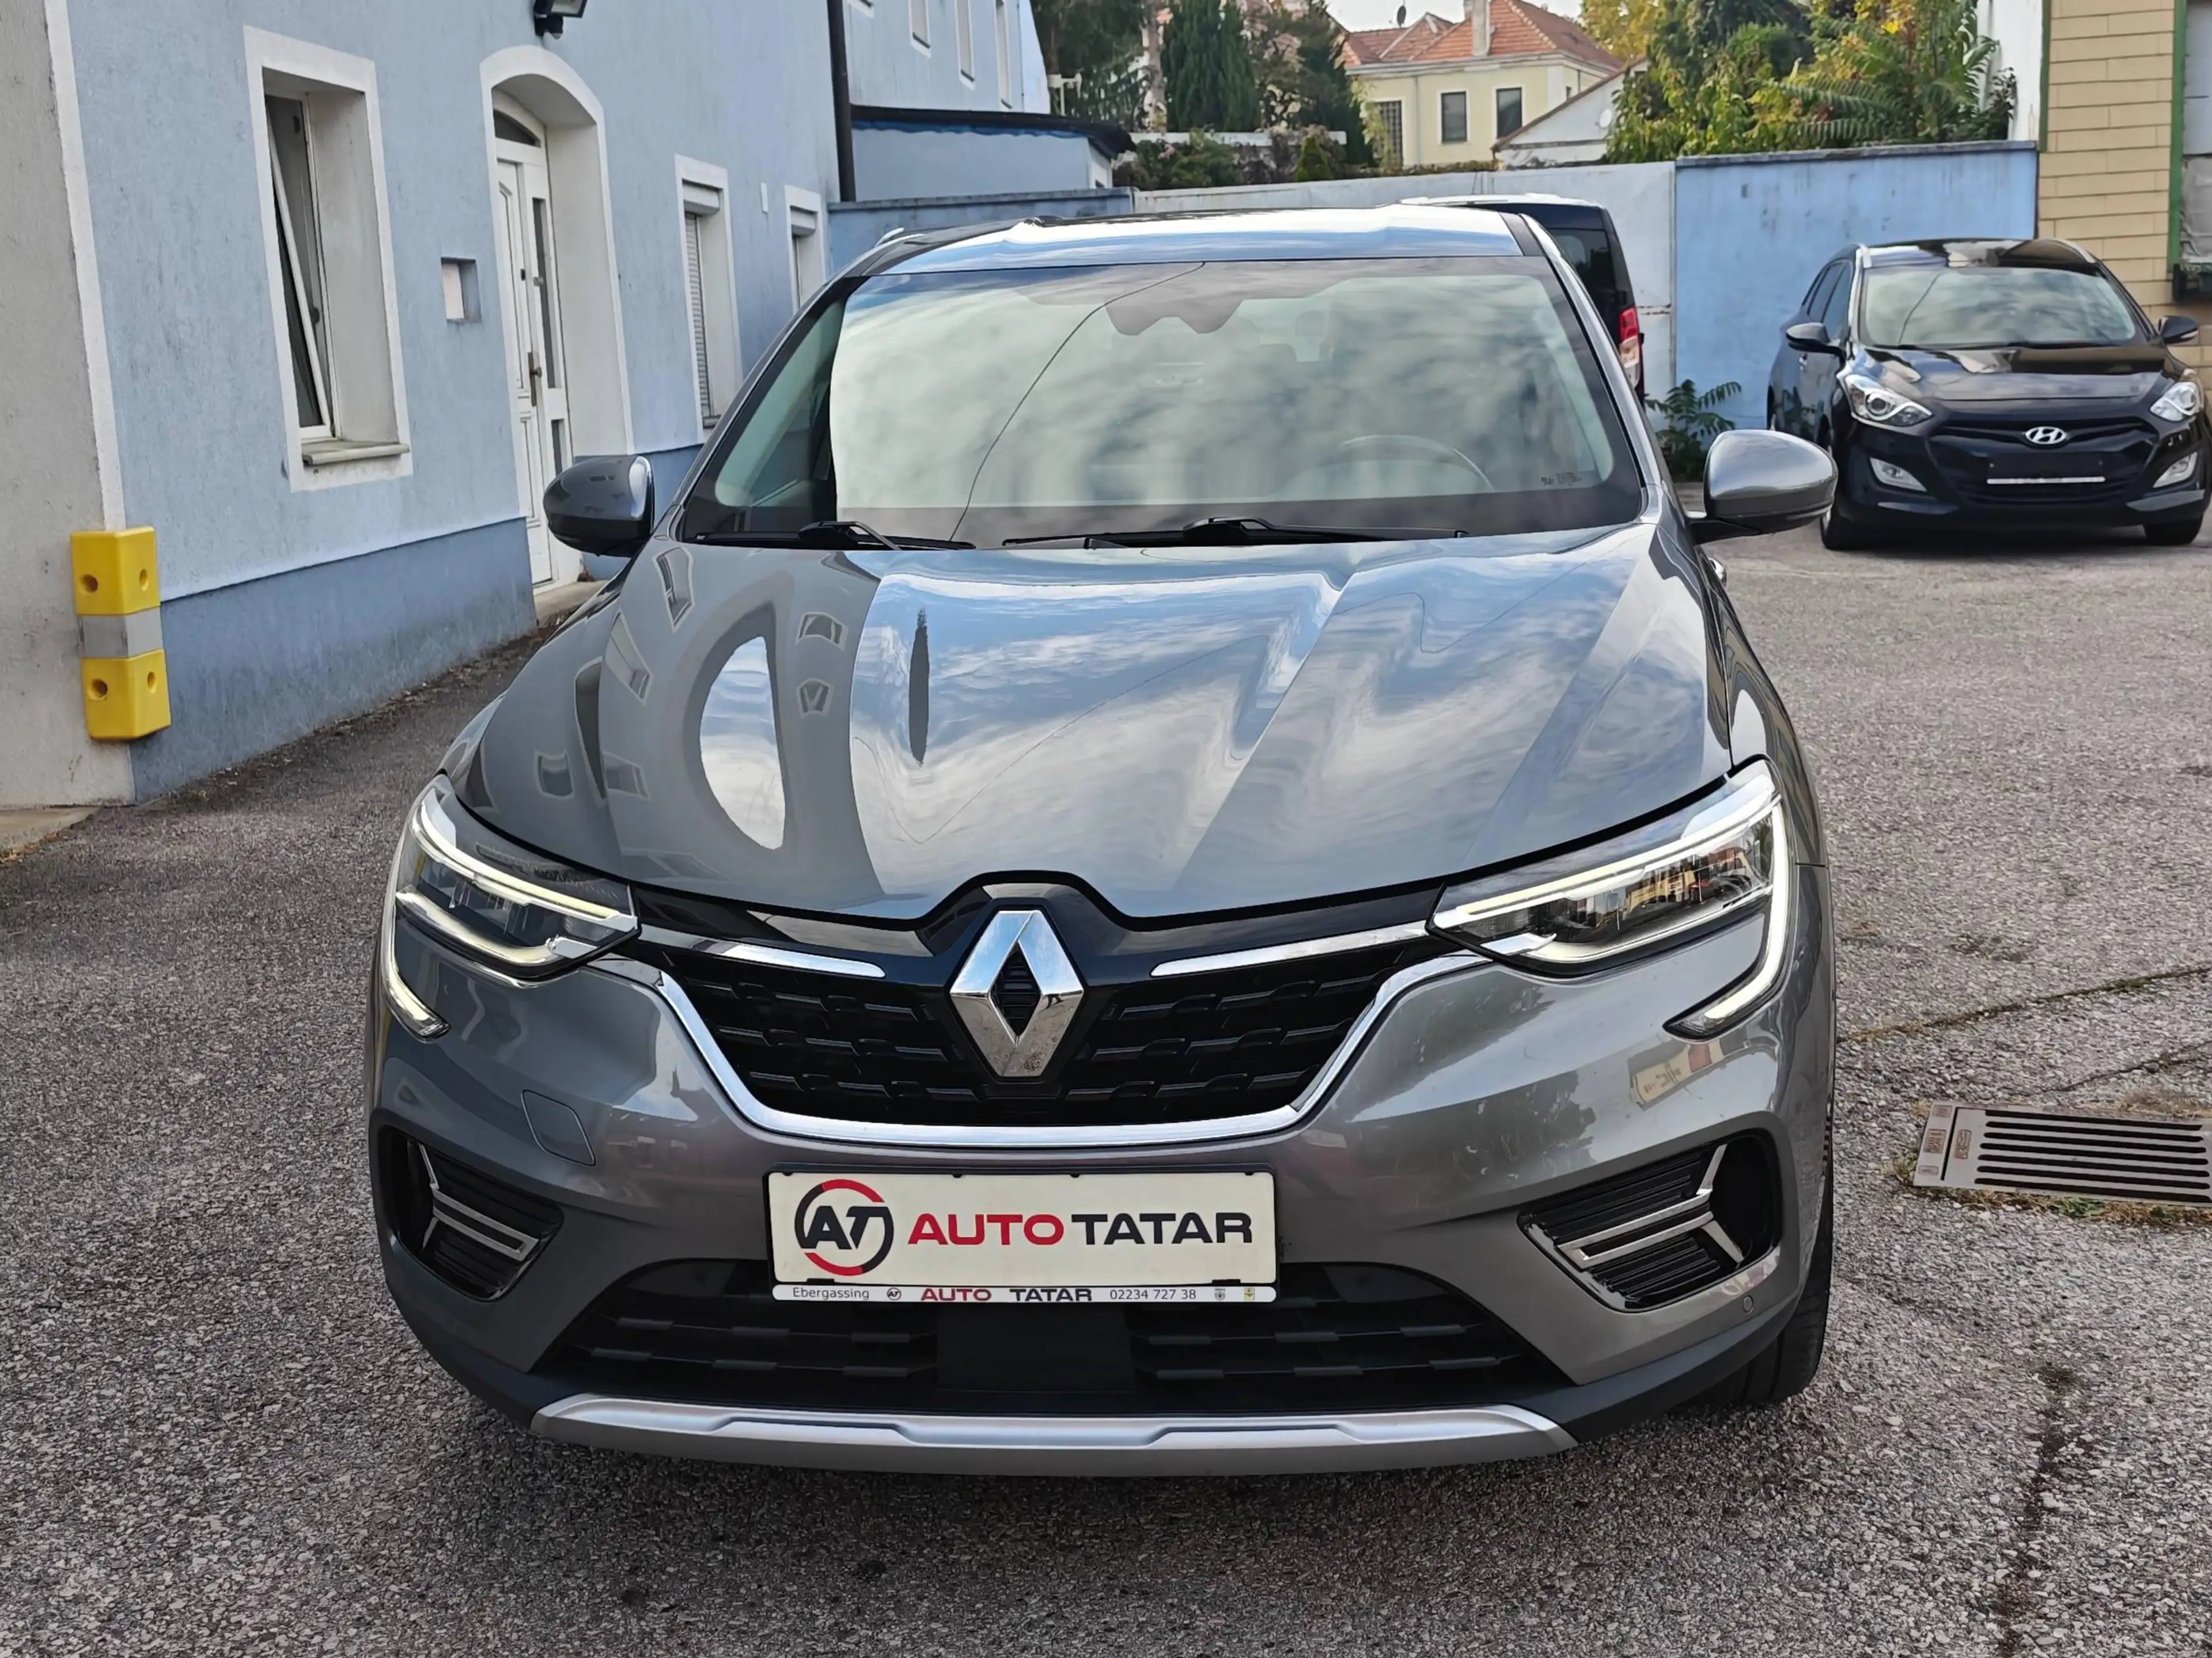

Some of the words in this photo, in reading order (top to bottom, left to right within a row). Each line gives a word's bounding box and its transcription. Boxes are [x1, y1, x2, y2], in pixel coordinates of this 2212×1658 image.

[802, 1206, 889, 1249] AT
[908, 1213, 1064, 1246] AUTO
[1071, 1212, 1252, 1245] TATAR
[793, 1287, 869, 1300] Ebergassing
[921, 1288, 992, 1301] AUTO
[1010, 1288, 1092, 1301] TATAR
[1110, 1289, 1148, 1300] 02234
[1153, 1289, 1176, 1299] 727
[1181, 1289, 1196, 1299] 38
